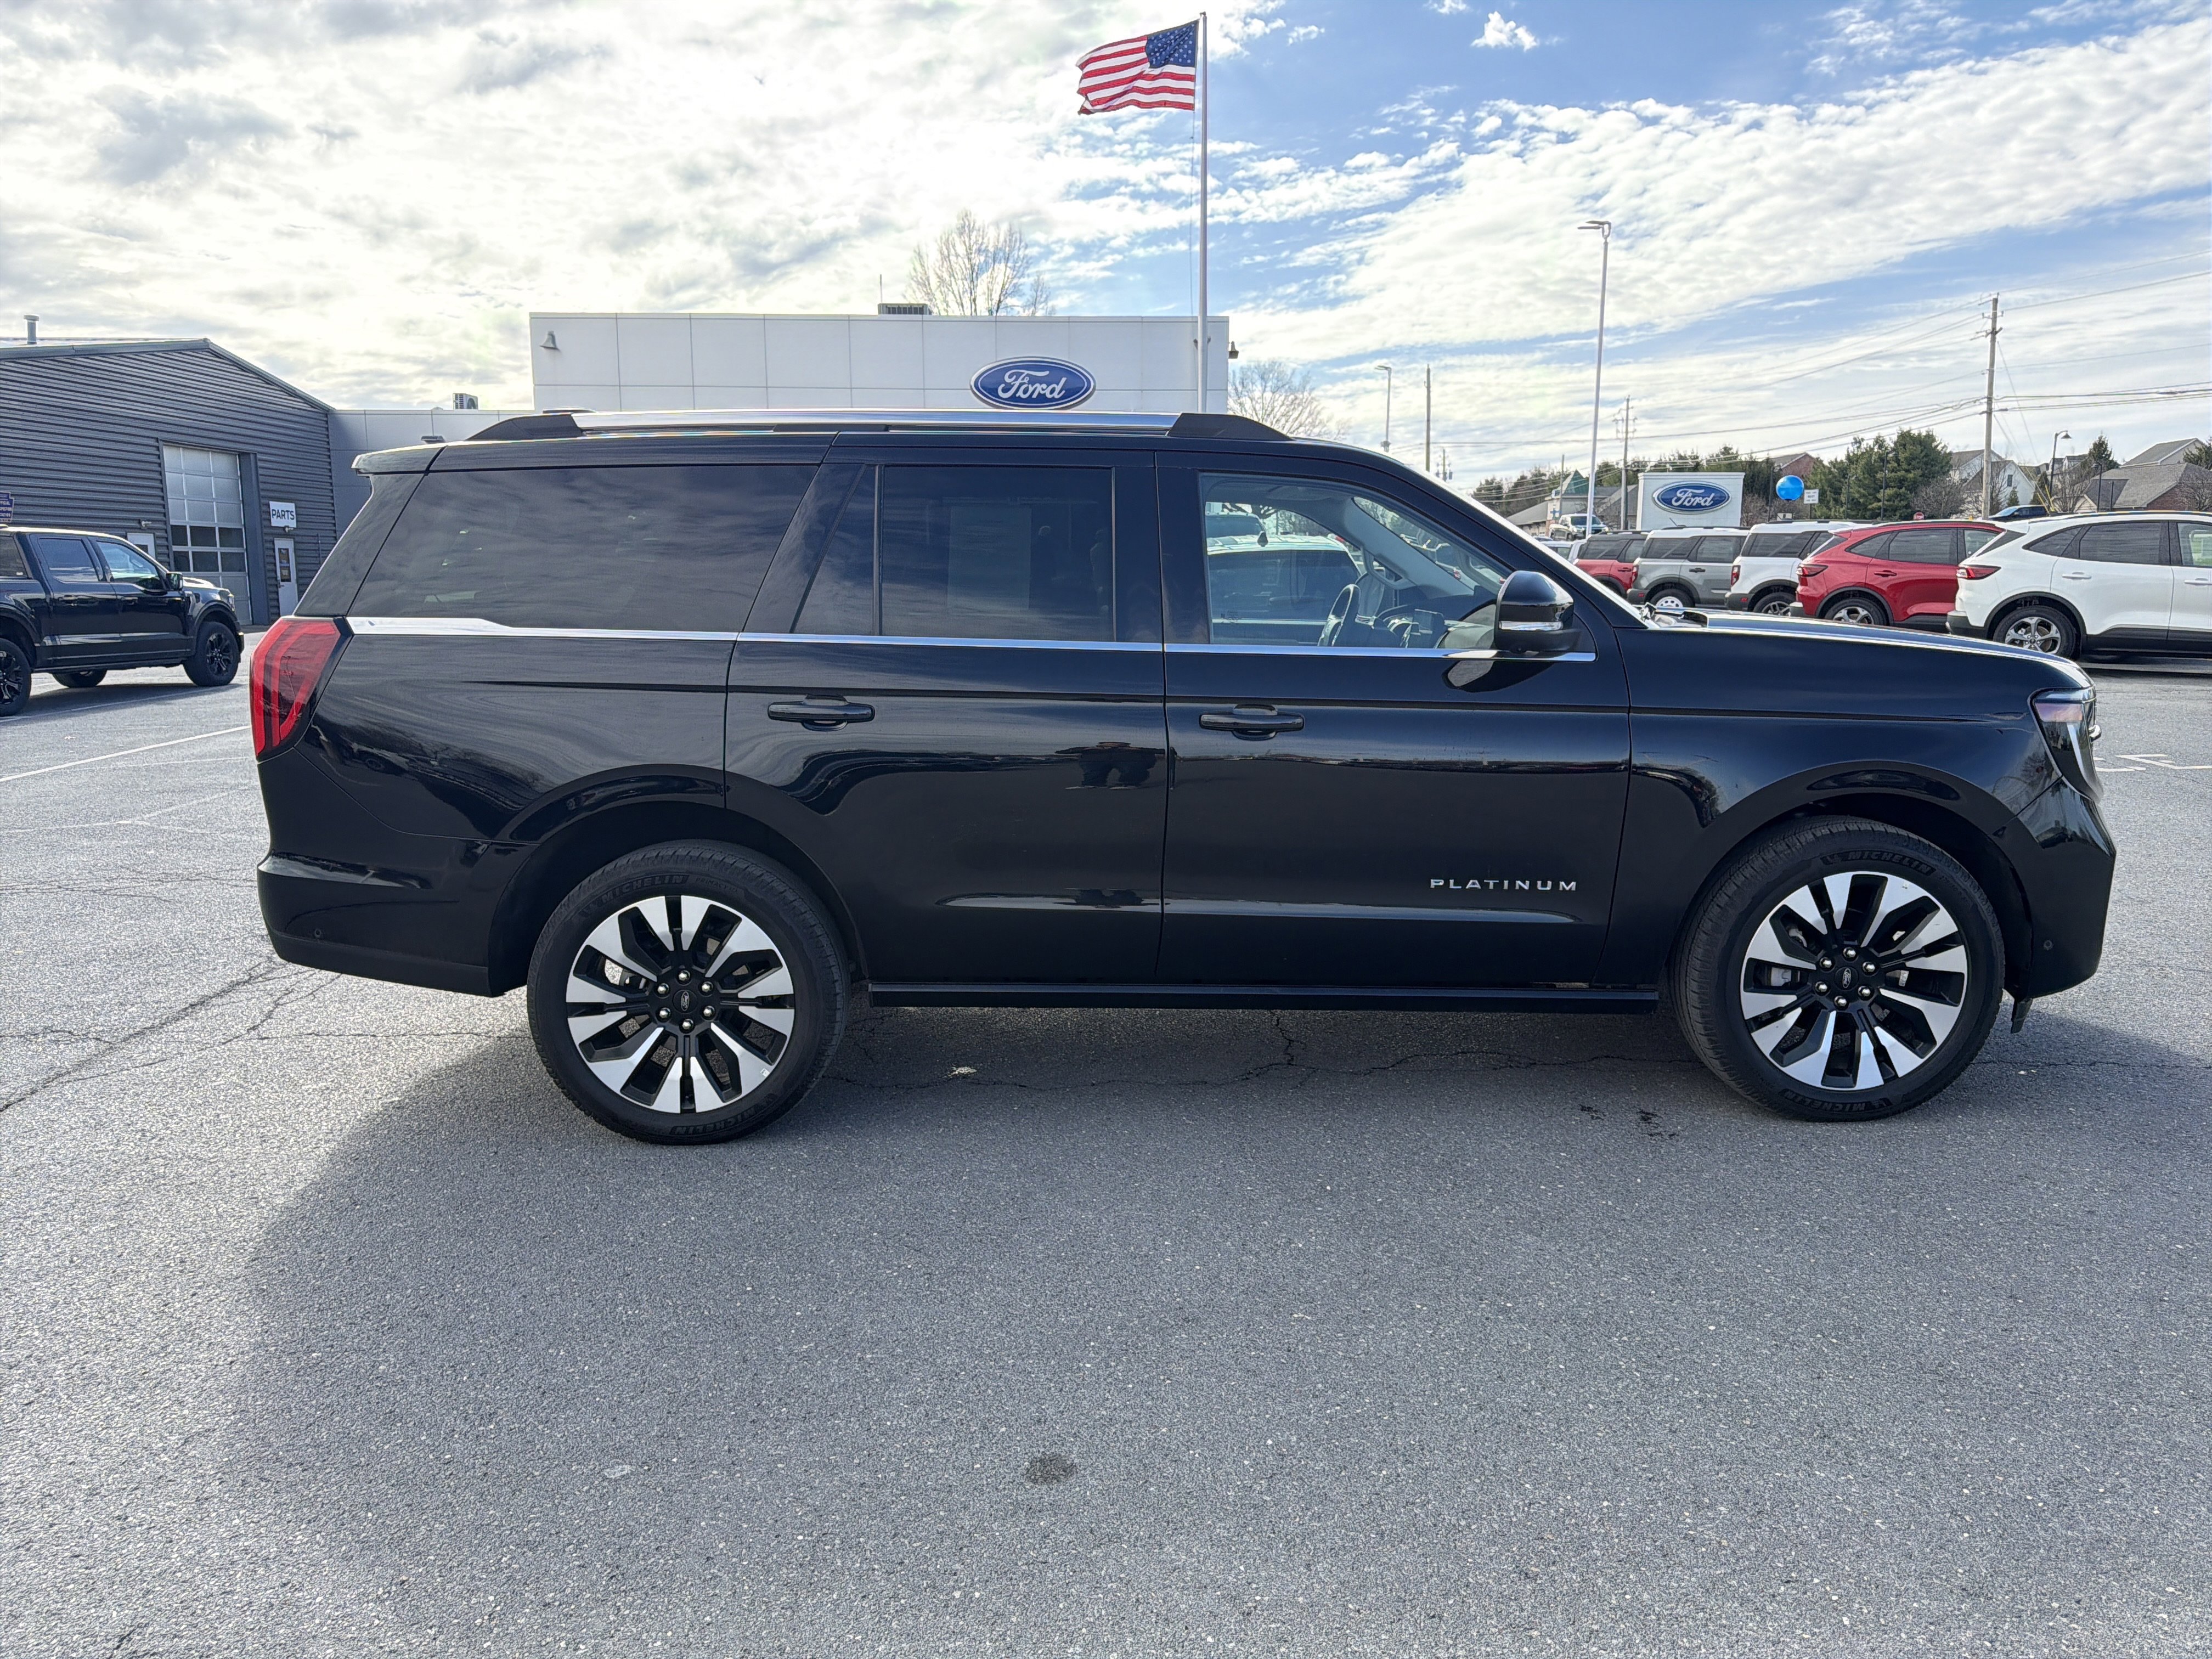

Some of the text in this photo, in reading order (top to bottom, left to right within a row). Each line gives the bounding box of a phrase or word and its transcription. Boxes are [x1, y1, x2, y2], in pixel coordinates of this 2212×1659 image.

[997, 369, 1067, 399] Ford
[1672, 488, 1714, 506] Ford
[272, 509, 295, 521] PARTS
[1847, 850, 1932, 874] MICHELIN
[601, 875, 684, 904] MICHELIN
[1430, 879, 1576, 891] PLATINUM
[1784, 1089, 1865, 1112] MICHELIN
